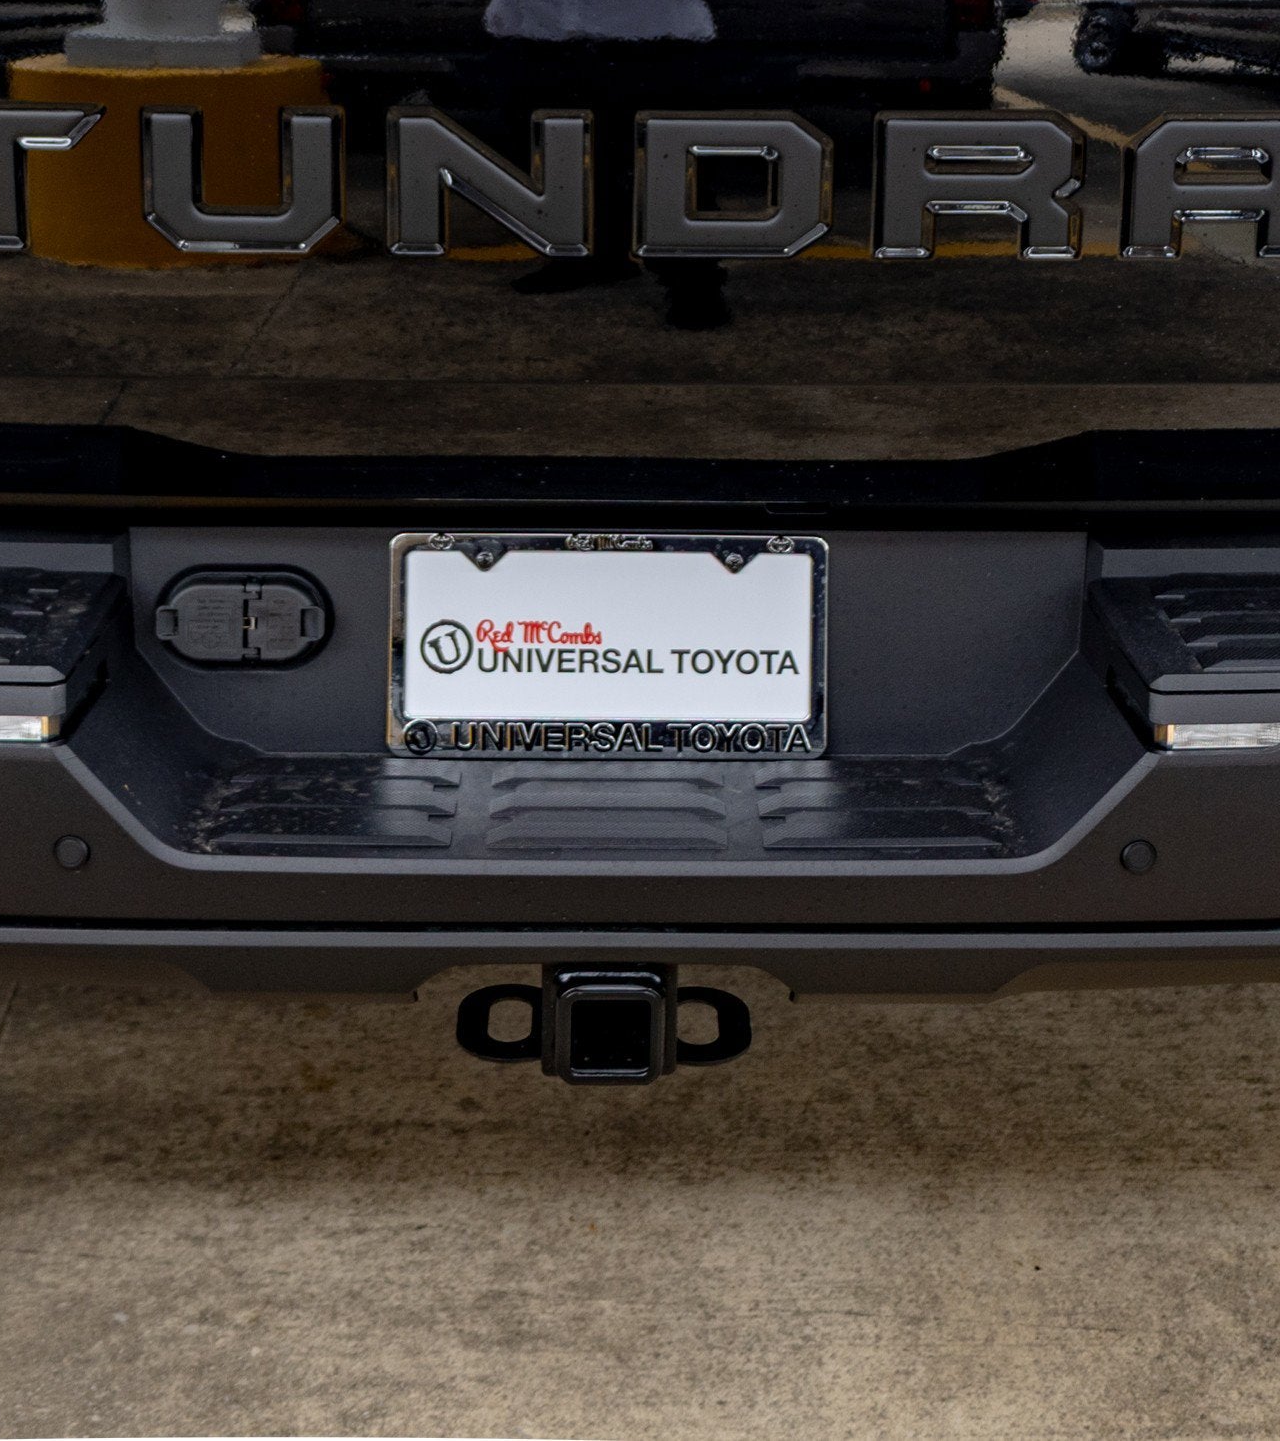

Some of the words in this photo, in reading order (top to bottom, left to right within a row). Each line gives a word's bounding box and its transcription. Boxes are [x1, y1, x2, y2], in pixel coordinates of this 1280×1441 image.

[476, 619, 513, 654] Red
[517, 620, 603, 645] McCombs
[477, 648, 664, 674] UNIVERSAL
[671, 648, 800, 675] TOYOTA
[451, 721, 664, 752] UNIVERSAL
[669, 722, 812, 753] TOYOTA
